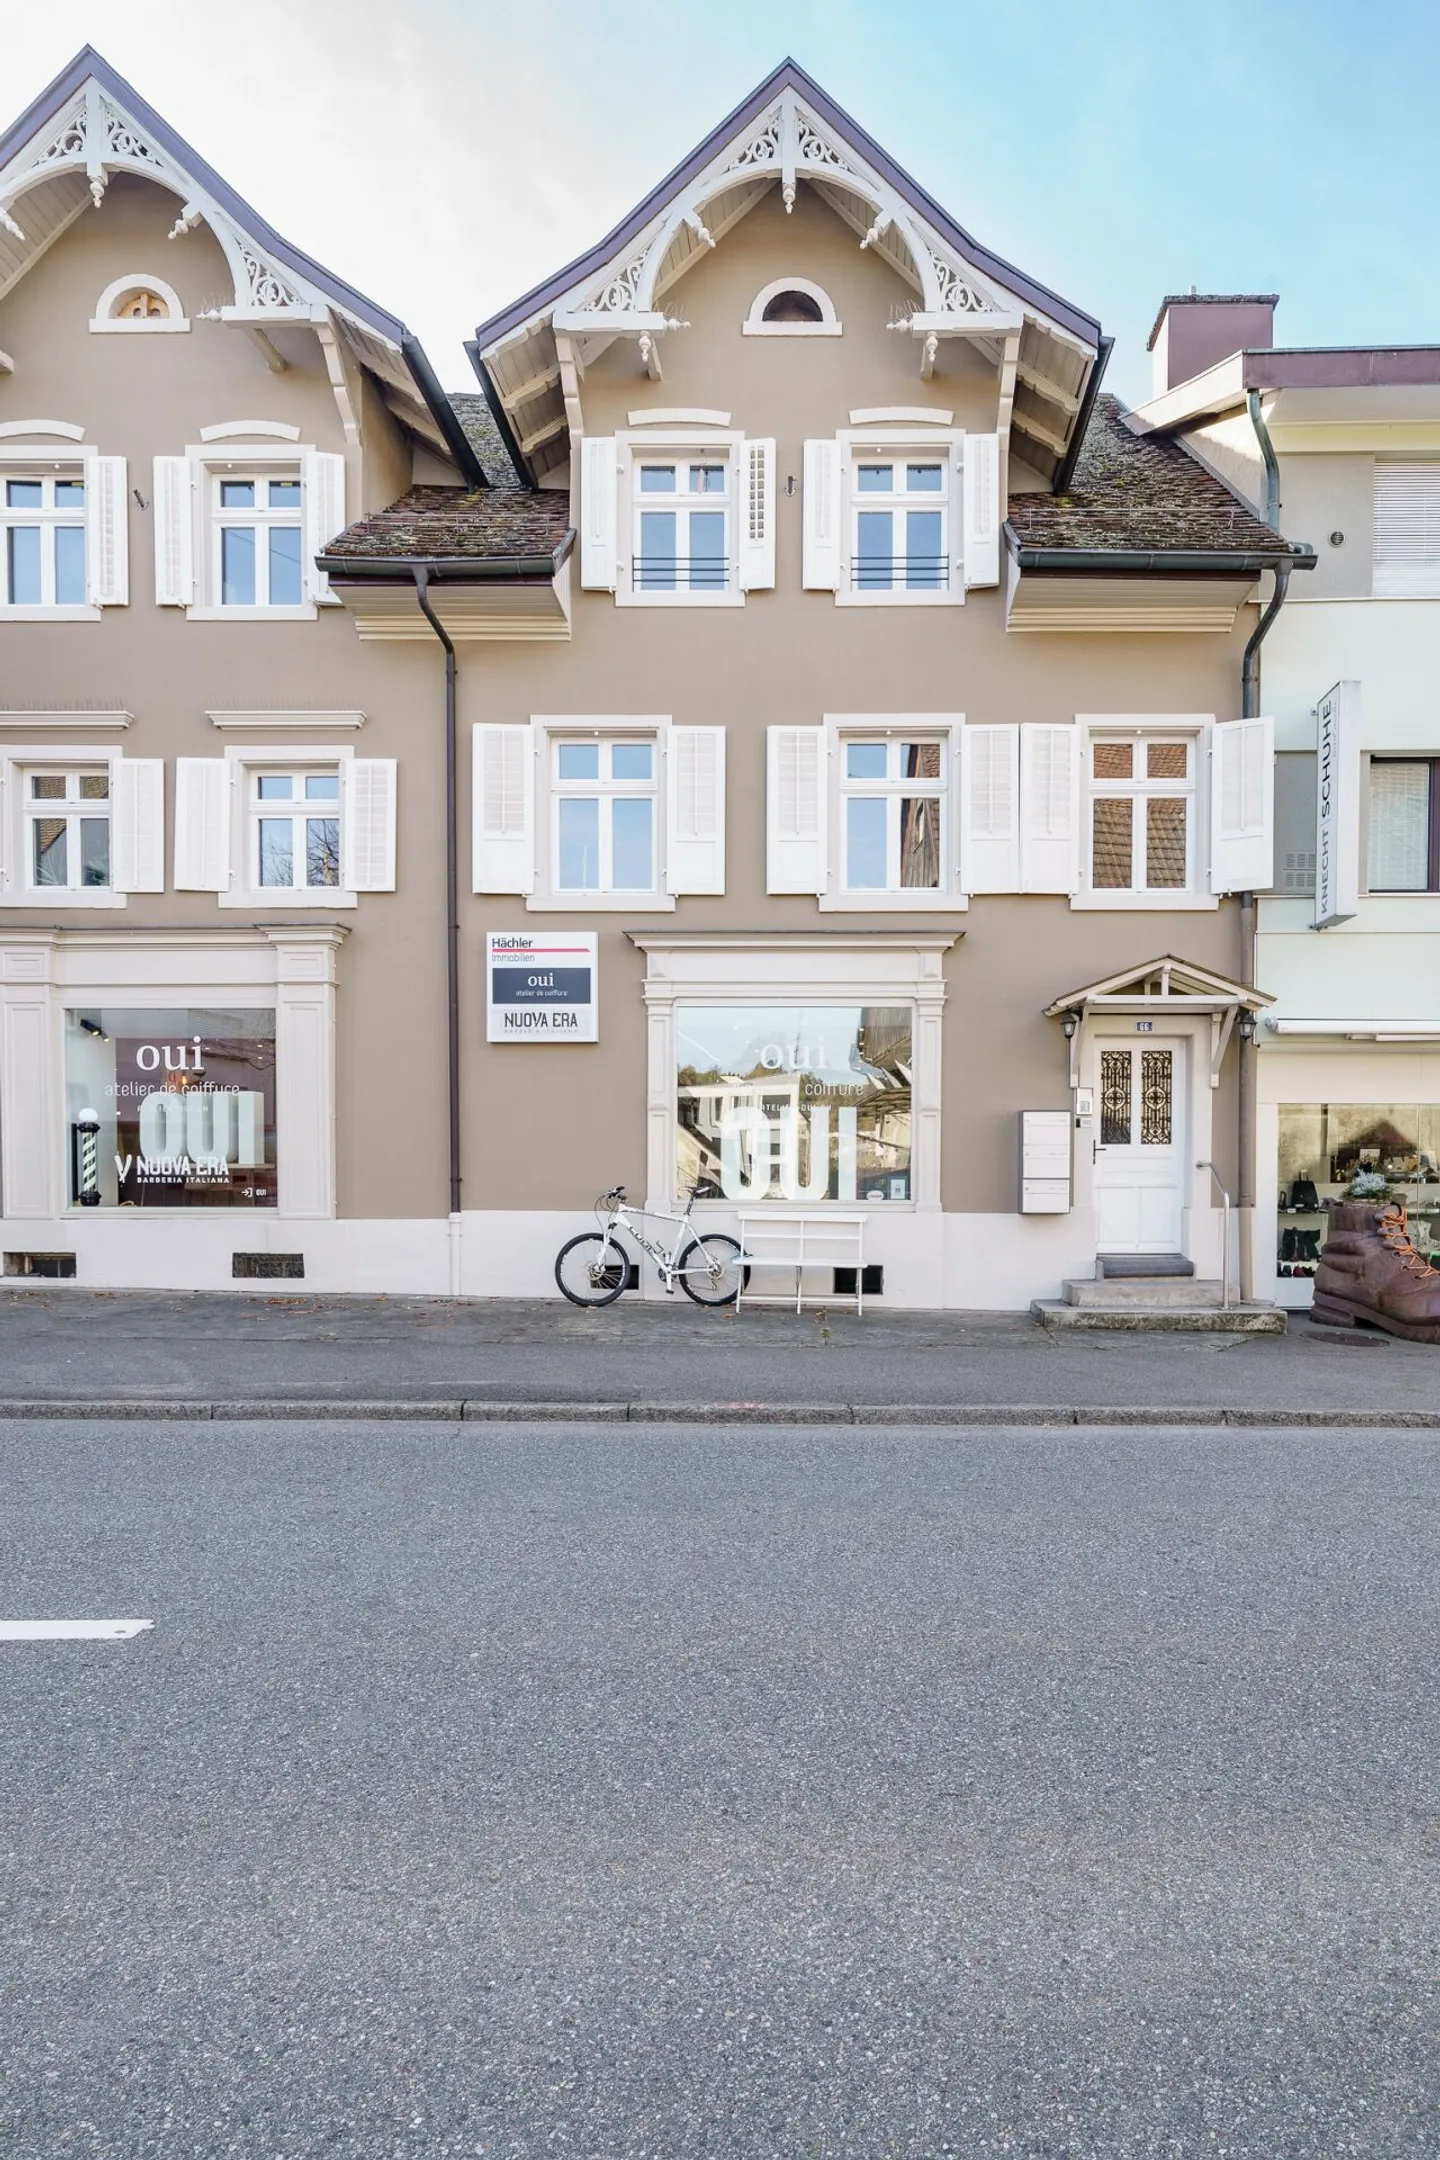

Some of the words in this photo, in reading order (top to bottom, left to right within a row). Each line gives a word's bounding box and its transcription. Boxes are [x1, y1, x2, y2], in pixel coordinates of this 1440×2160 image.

[1321, 700, 1332, 819] SCHUHE
[1321, 830, 1331, 915] KNECHT
[492, 938, 533, 948] Hächler
[492, 953, 535, 962] Immobilien
[527, 972, 554, 986] oui
[505, 1012, 548, 1027] NUOVA
[553, 1012, 578, 1027] ERA
[1139, 1022, 1150, 1031] 66
[136, 1036, 204, 1071] oui
[760, 1034, 828, 1069] oui
[104, 1082, 155, 1097] atelier
[159, 1081, 177, 1095] de
[182, 1081, 240, 1096] coiffure
[139, 1091, 265, 1165] OUI
[720, 1107, 858, 1200] OUI
[137, 1156, 191, 1176] NUOVA
[196, 1156, 229, 1176] ERA
